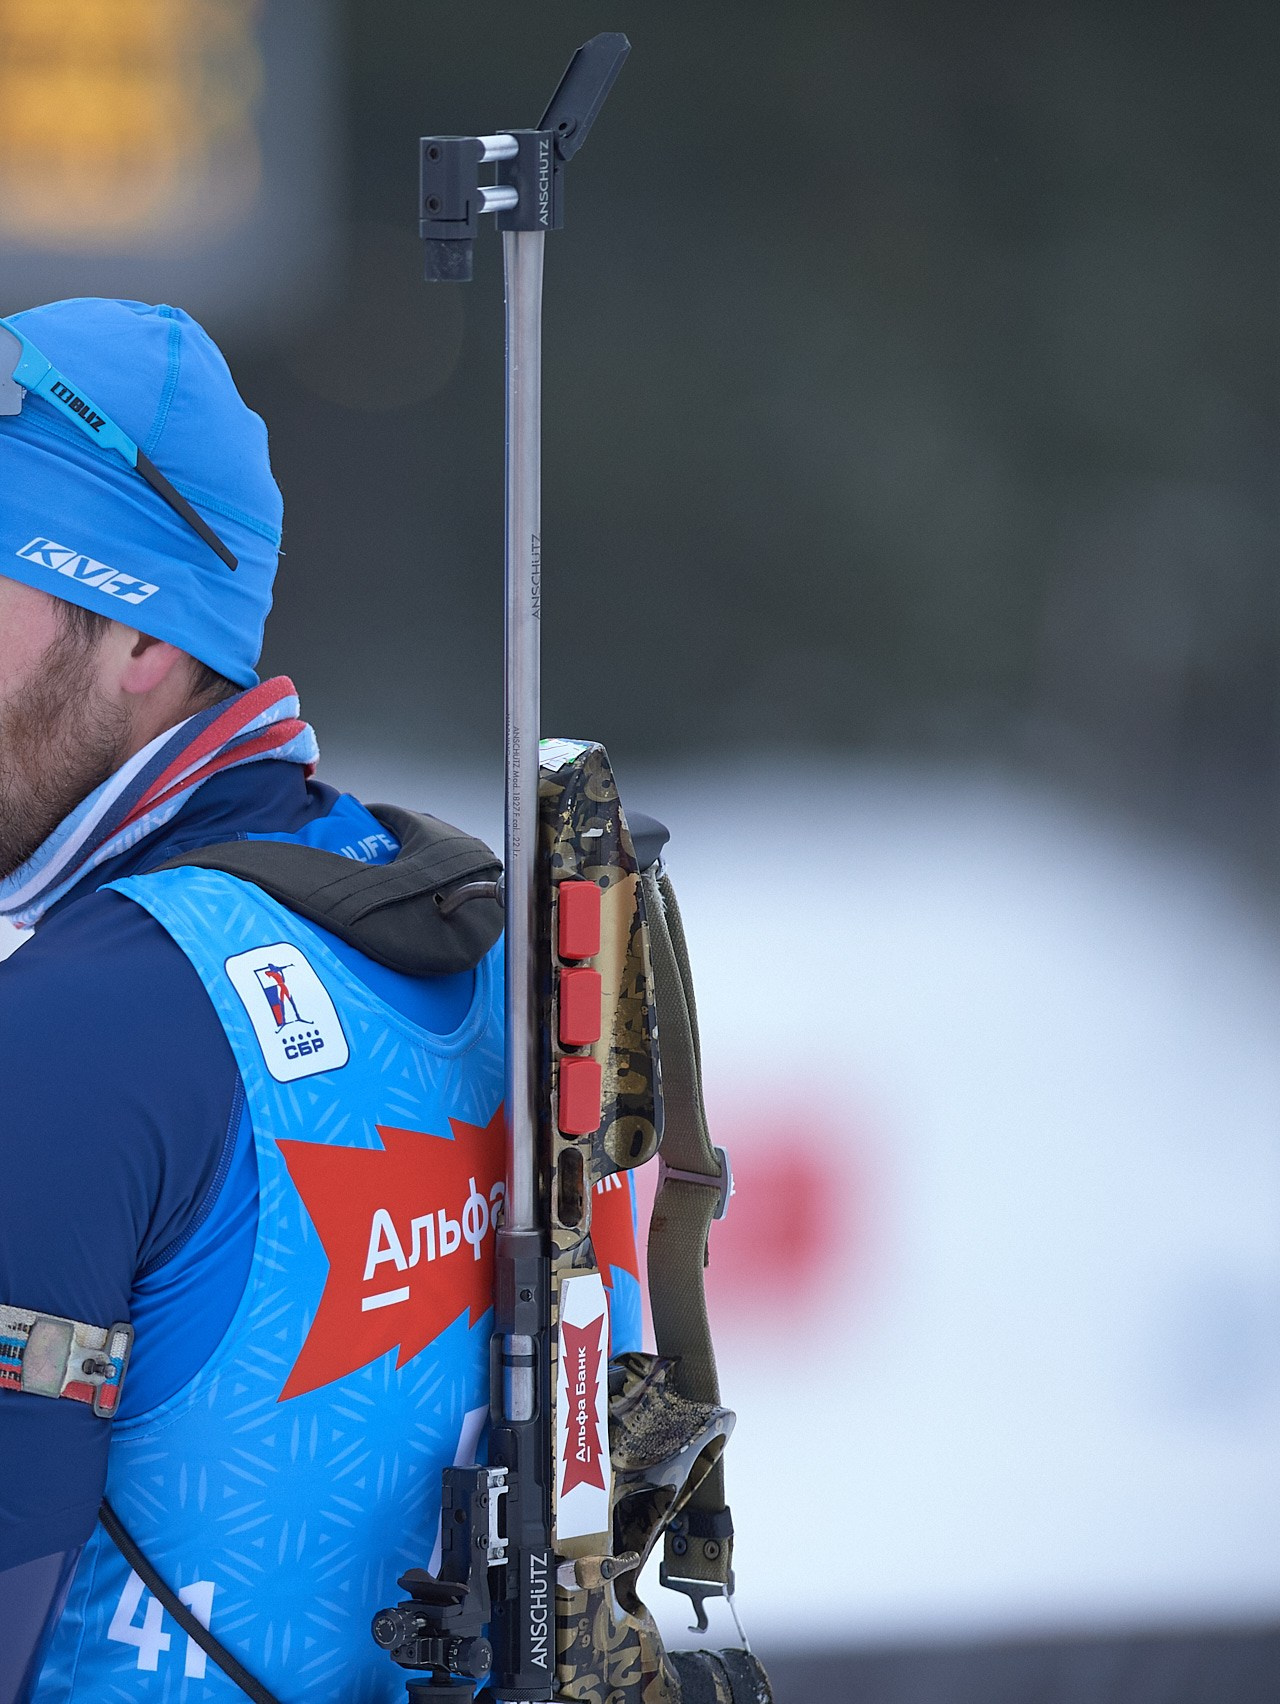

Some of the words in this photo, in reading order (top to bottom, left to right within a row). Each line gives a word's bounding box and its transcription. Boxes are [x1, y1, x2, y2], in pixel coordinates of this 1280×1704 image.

[285, 1037, 325, 1060] СБР
[575, 1346, 587, 1395] Банк
[576, 1398, 589, 1462] Альфа
[107, 1569, 215, 1679] 41
[530, 1552, 548, 1669] ANSCHÜTZ
